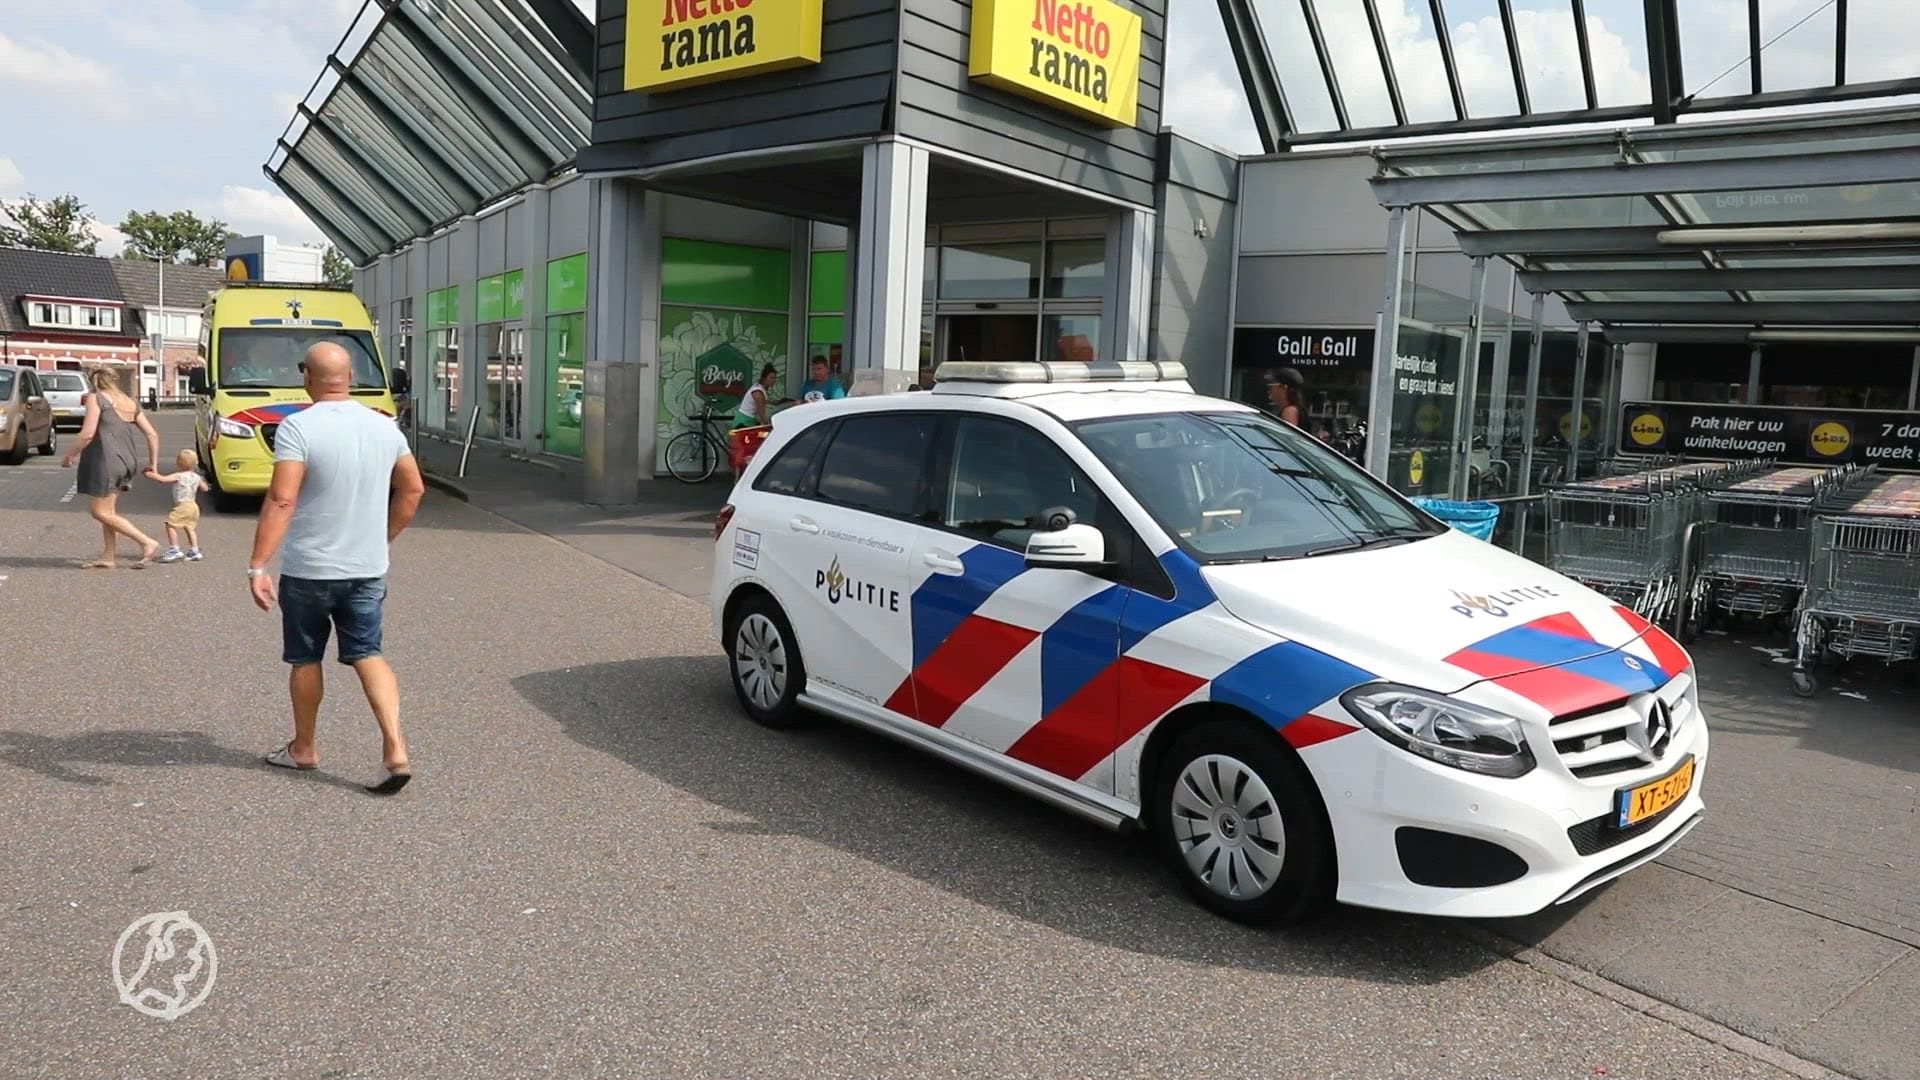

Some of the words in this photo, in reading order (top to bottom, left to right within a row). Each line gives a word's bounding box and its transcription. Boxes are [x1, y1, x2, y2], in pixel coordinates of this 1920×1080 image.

[1032, 0, 1110, 59] Netto
[661, 15, 755, 71] rama
[1029, 37, 1108, 104] rama
[1278, 335, 1312, 356] Gall
[1321, 336, 1357, 357] Gall
[1292, 358, 1317, 366] SINDS
[1399, 377, 1408, 391] en
[1690, 416, 1720, 430] Pak
[1723, 417, 1754, 431] hier
[1758, 421, 1784, 432] uw
[1881, 424, 1894, 437] 7
[1897, 423, 1920, 438] da
[1684, 435, 1786, 453] winkelwagen
[1866, 445, 1913, 460] week
[815, 568, 900, 613] POLITIE
[1449, 585, 1560, 619] POLITIE
